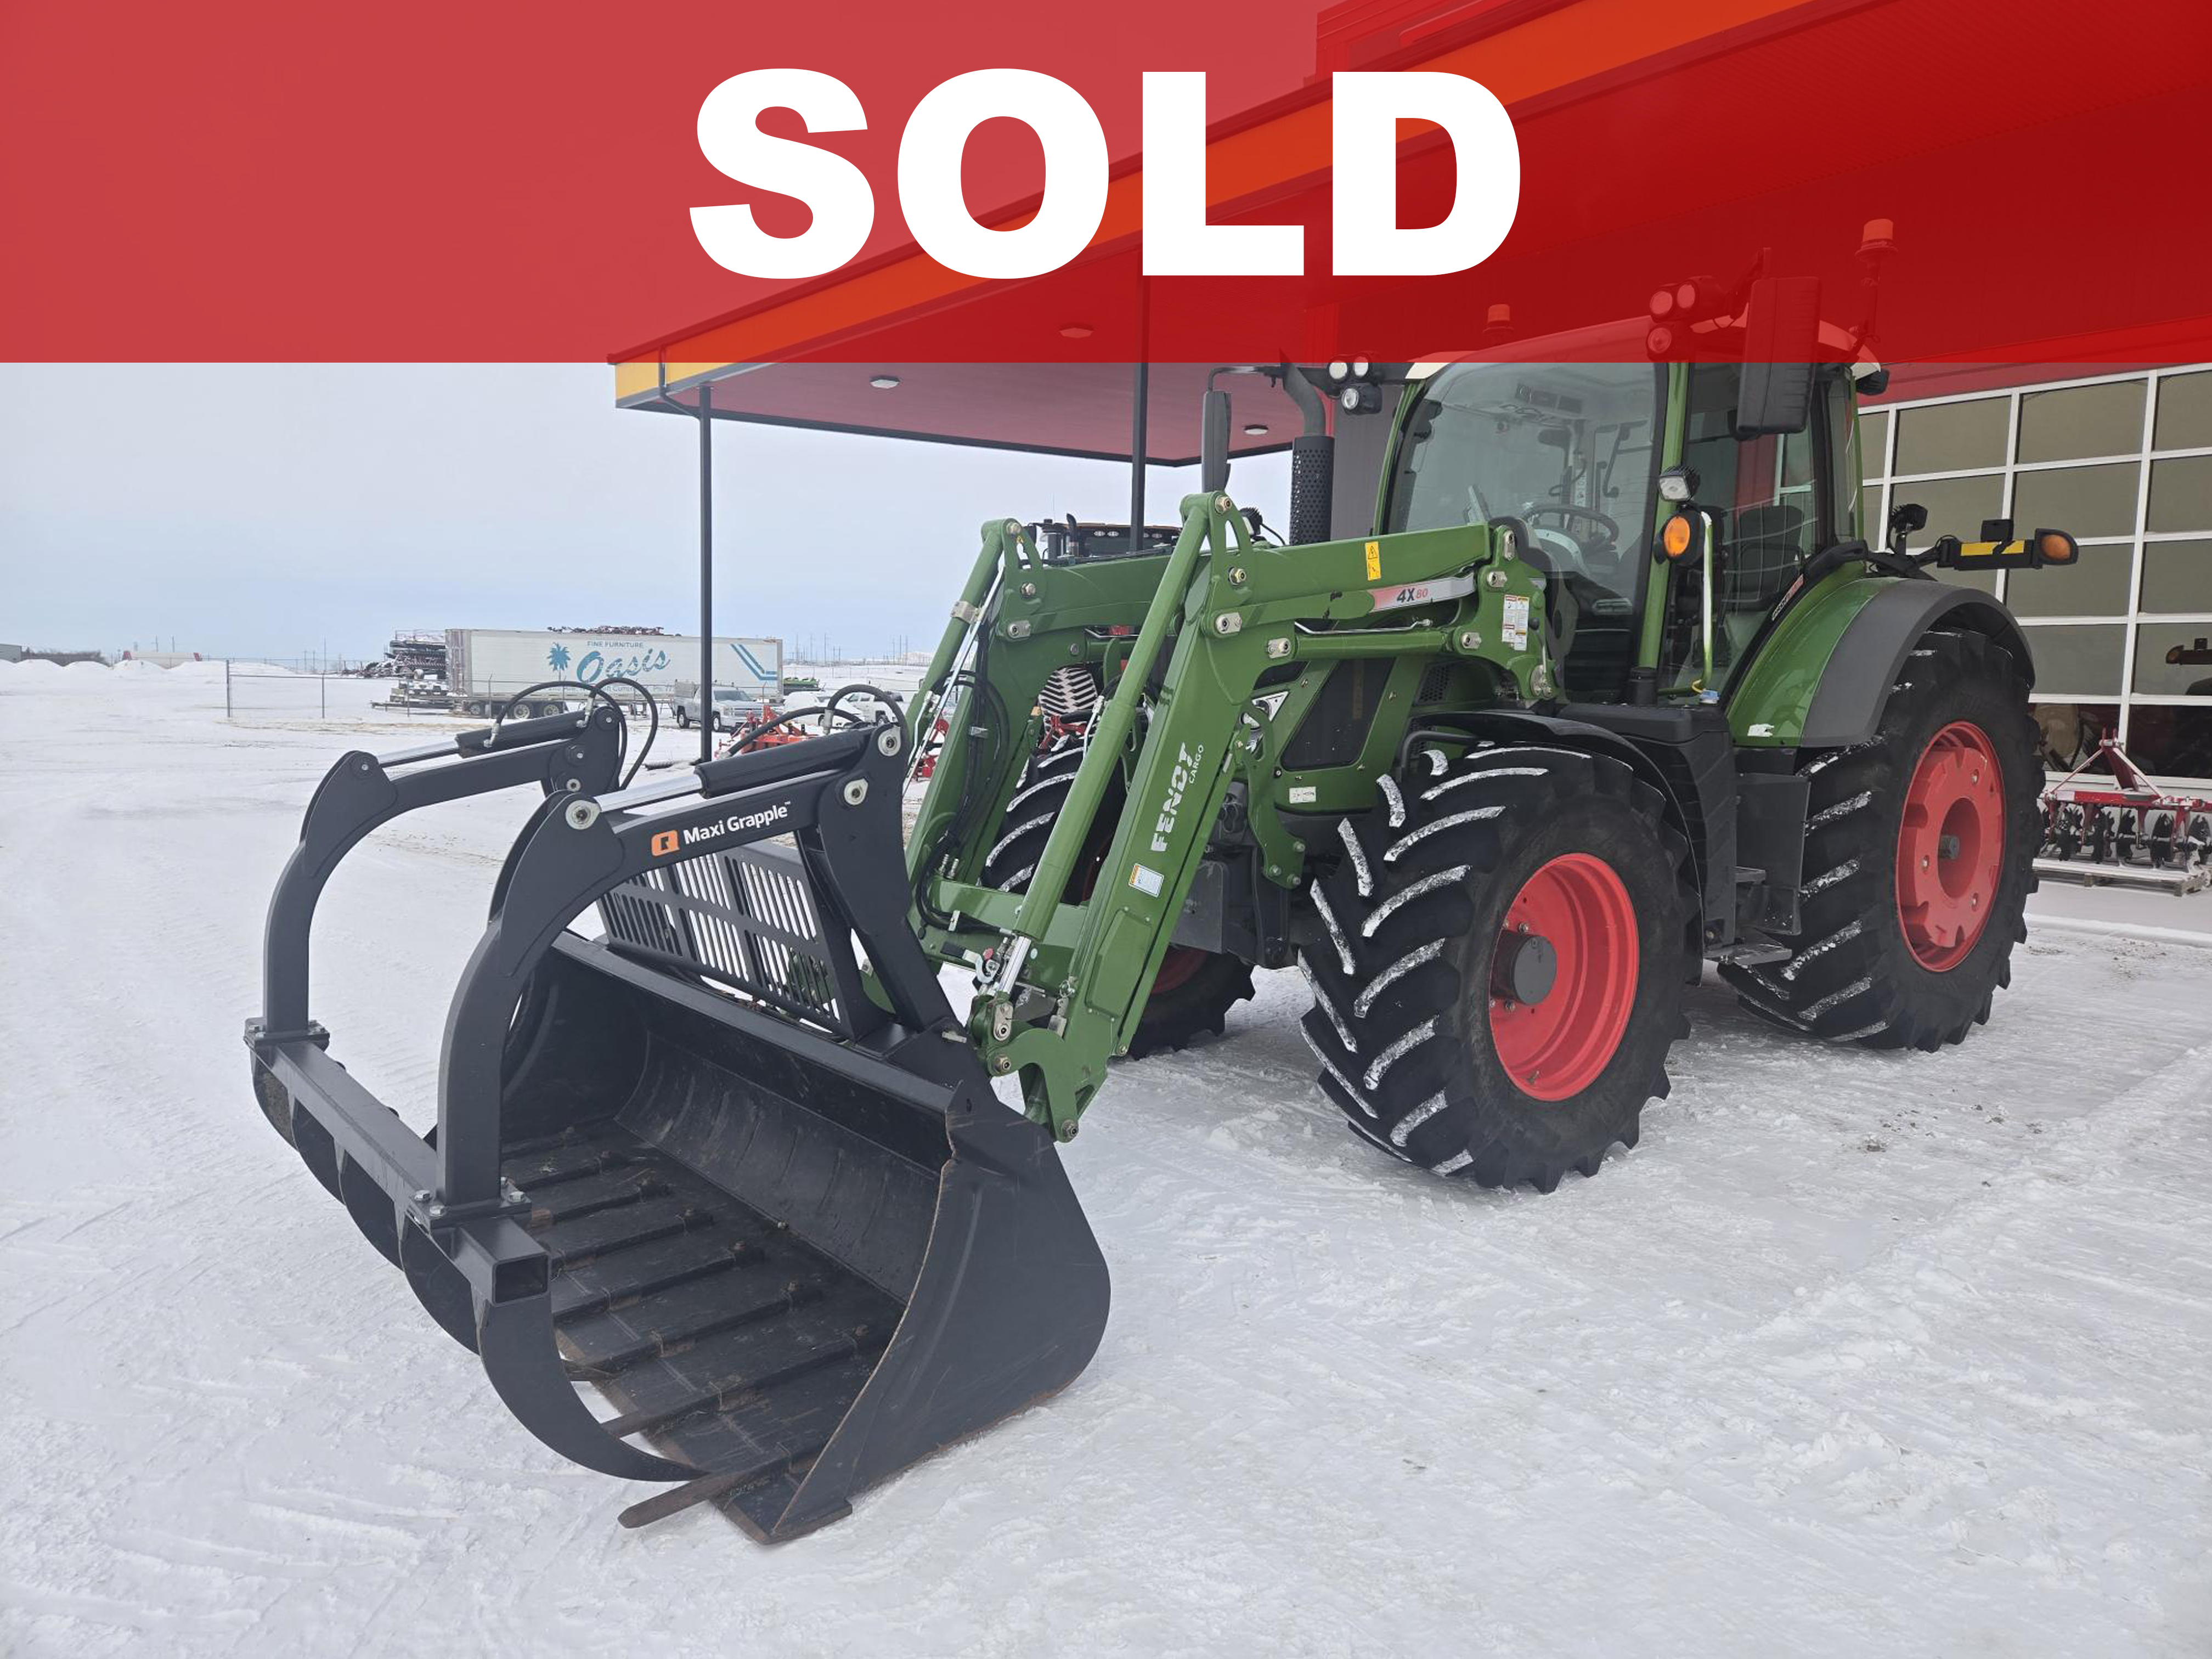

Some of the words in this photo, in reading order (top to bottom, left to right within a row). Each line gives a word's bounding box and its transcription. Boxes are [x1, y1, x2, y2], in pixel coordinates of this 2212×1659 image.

[577, 648, 671, 683] Oasis
[1189, 744, 1204, 783] CARGO
[1151, 742, 1193, 851] FENDT
[683, 820, 725, 844] Maxi
